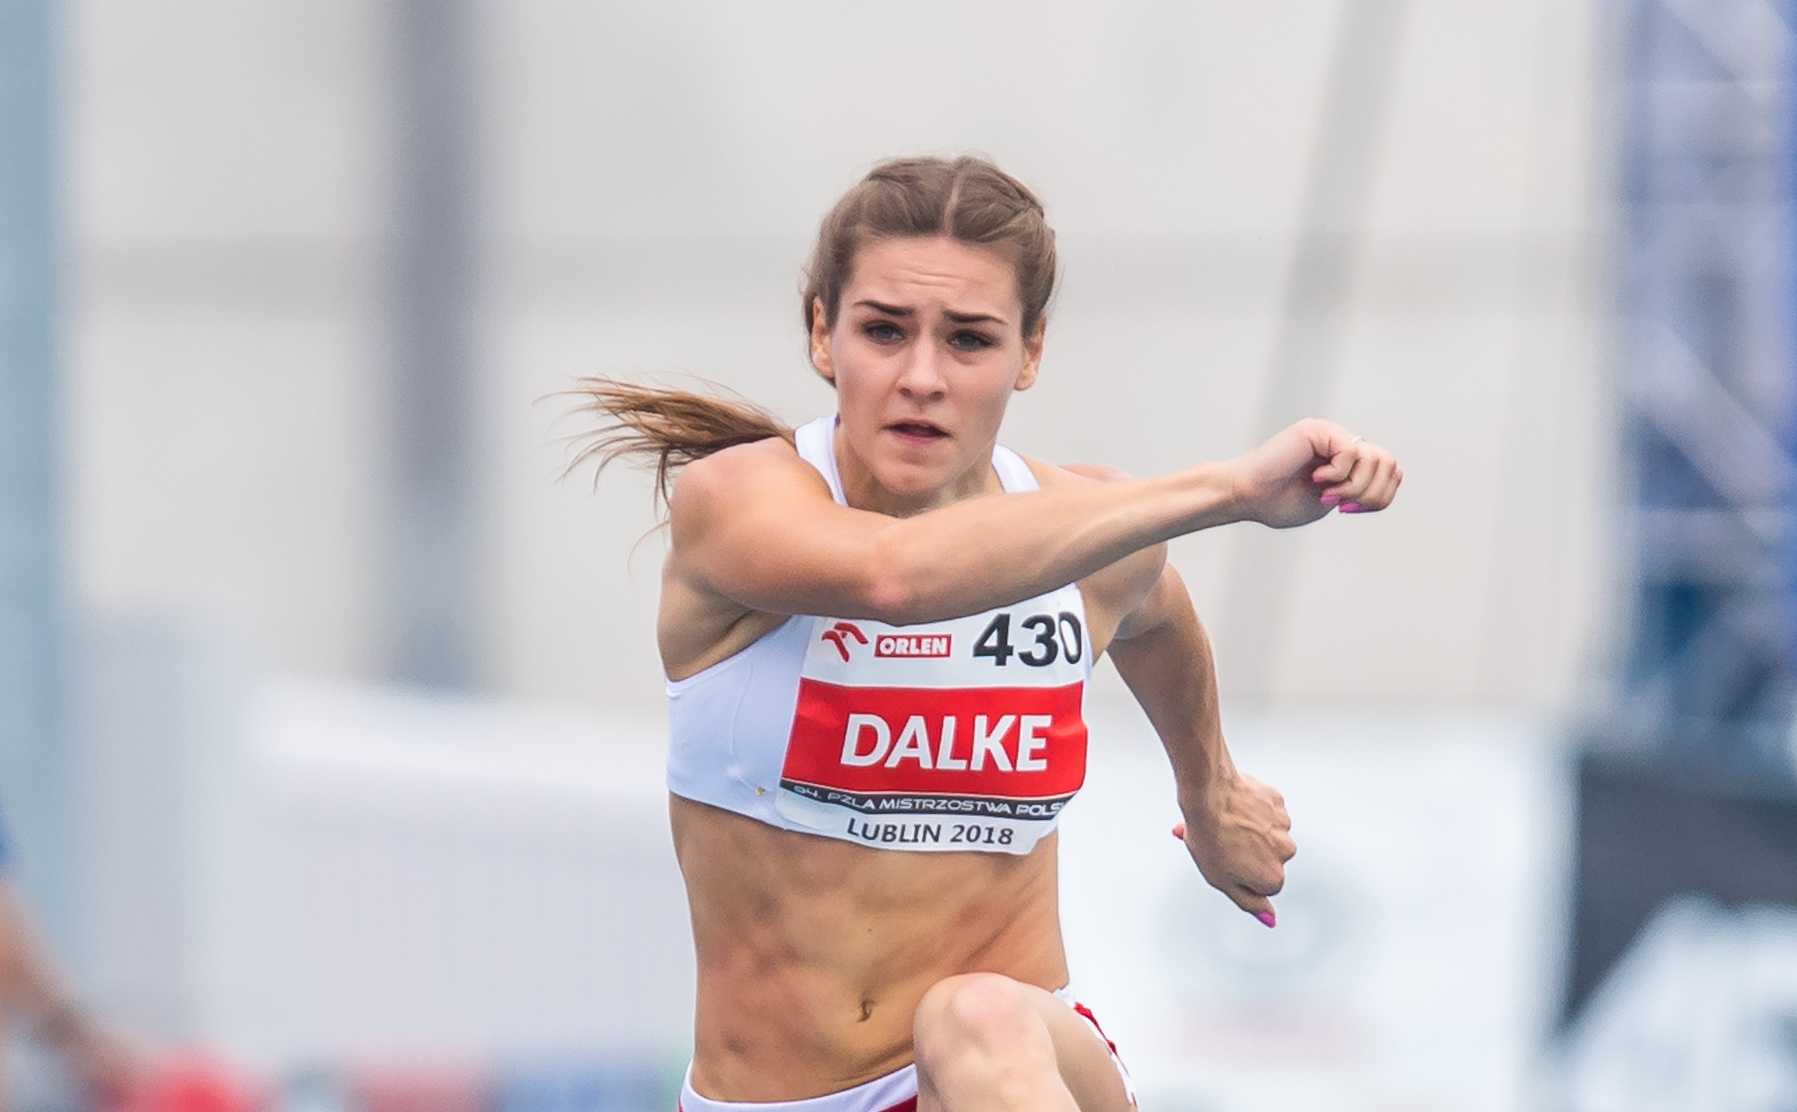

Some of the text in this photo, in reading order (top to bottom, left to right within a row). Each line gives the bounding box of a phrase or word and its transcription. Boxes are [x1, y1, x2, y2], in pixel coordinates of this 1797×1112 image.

[879, 636, 948, 655] ORLEN
[972, 612, 1083, 667] 430
[840, 713, 1053, 772] DALKE
[827, 791, 876, 810] PZLA
[879, 798, 1012, 815] MISTRZOSTWA
[1015, 801, 1064, 816] POLS
[846, 817, 1015, 846] LUBLIN 2018
